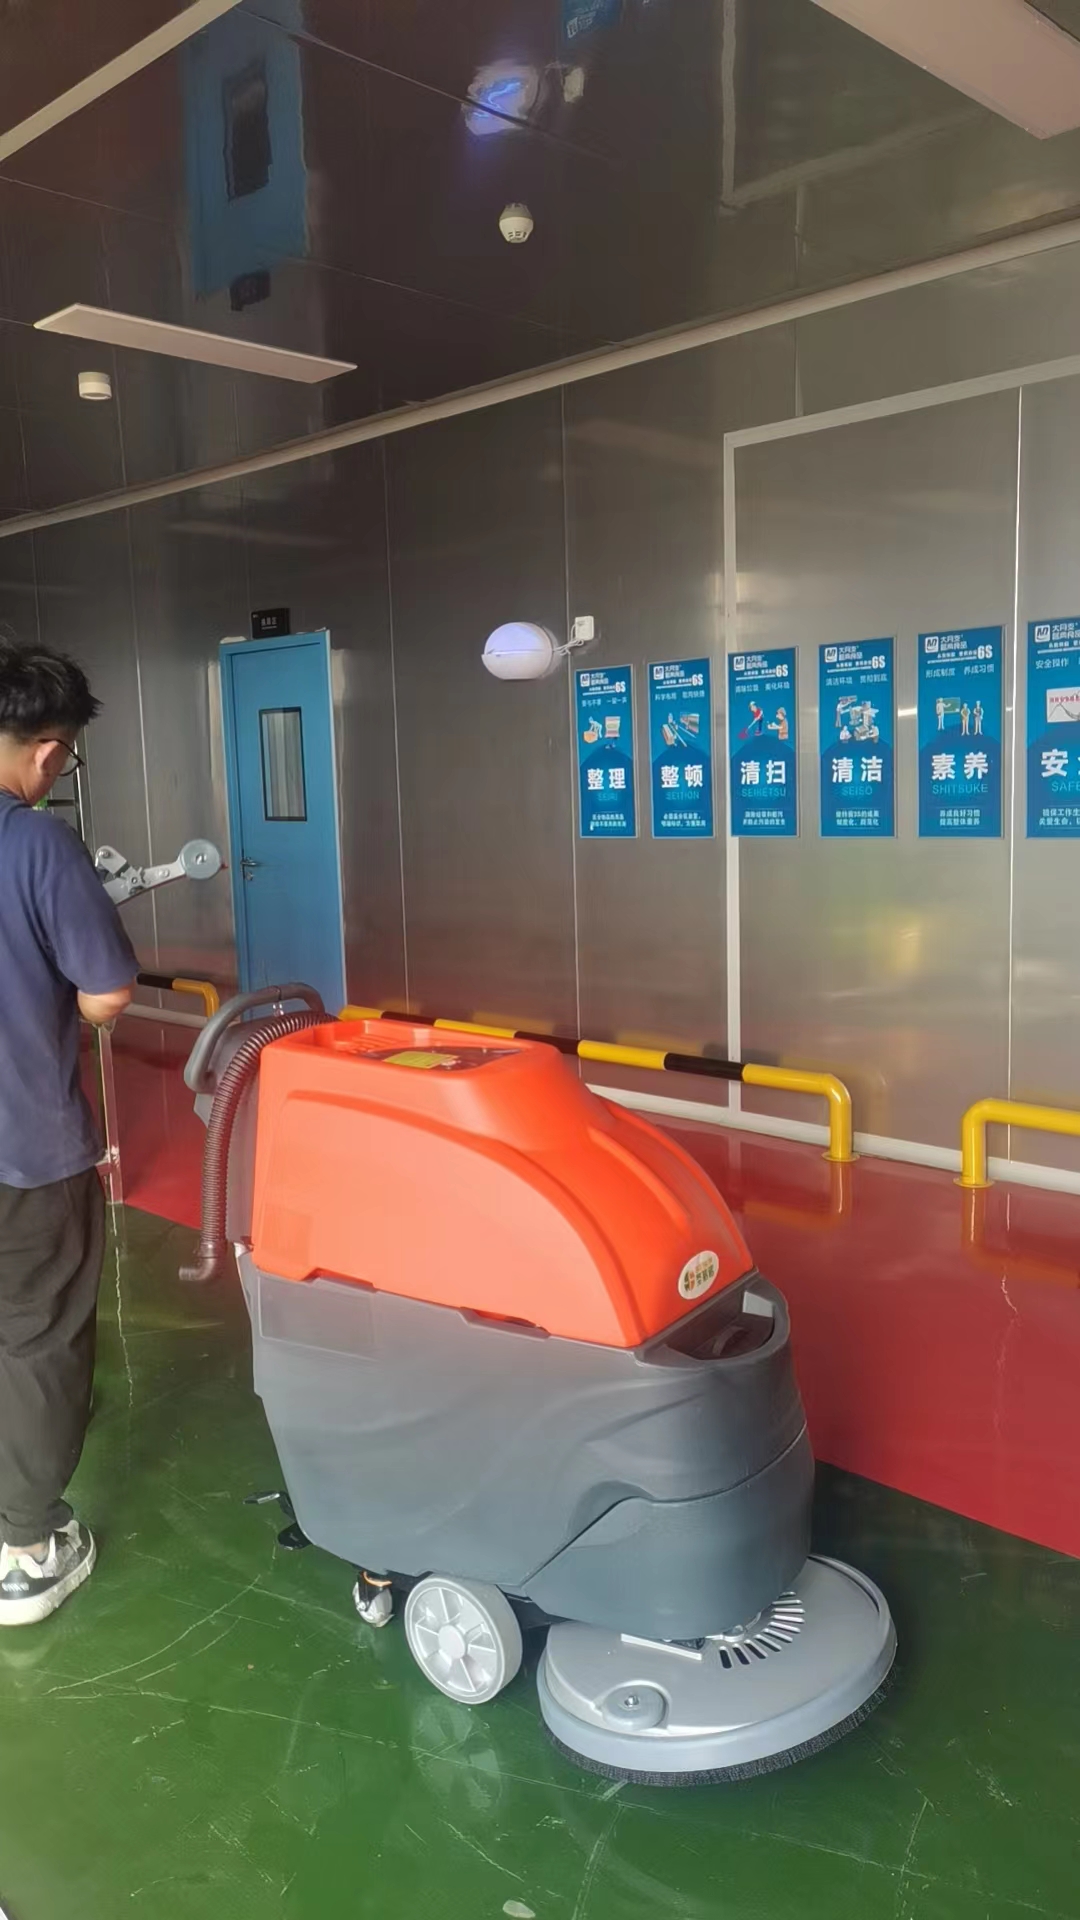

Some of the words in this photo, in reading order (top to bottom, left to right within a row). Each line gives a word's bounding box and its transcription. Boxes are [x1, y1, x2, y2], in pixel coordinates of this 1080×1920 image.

[872, 655, 886, 669] 6S
[977, 645, 993, 659] 6S
[691, 673, 704, 686] 6S
[775, 664, 789, 677] 6S
[615, 681, 627, 693] 6S
[740, 760, 787, 785] 清扫
[831, 756, 884, 783] 清洁
[931, 752, 989, 781] 素养
[1040, 748, 1080, 778] 安
[587, 768, 627, 790] 整理
[660, 764, 704, 788] 整顿
